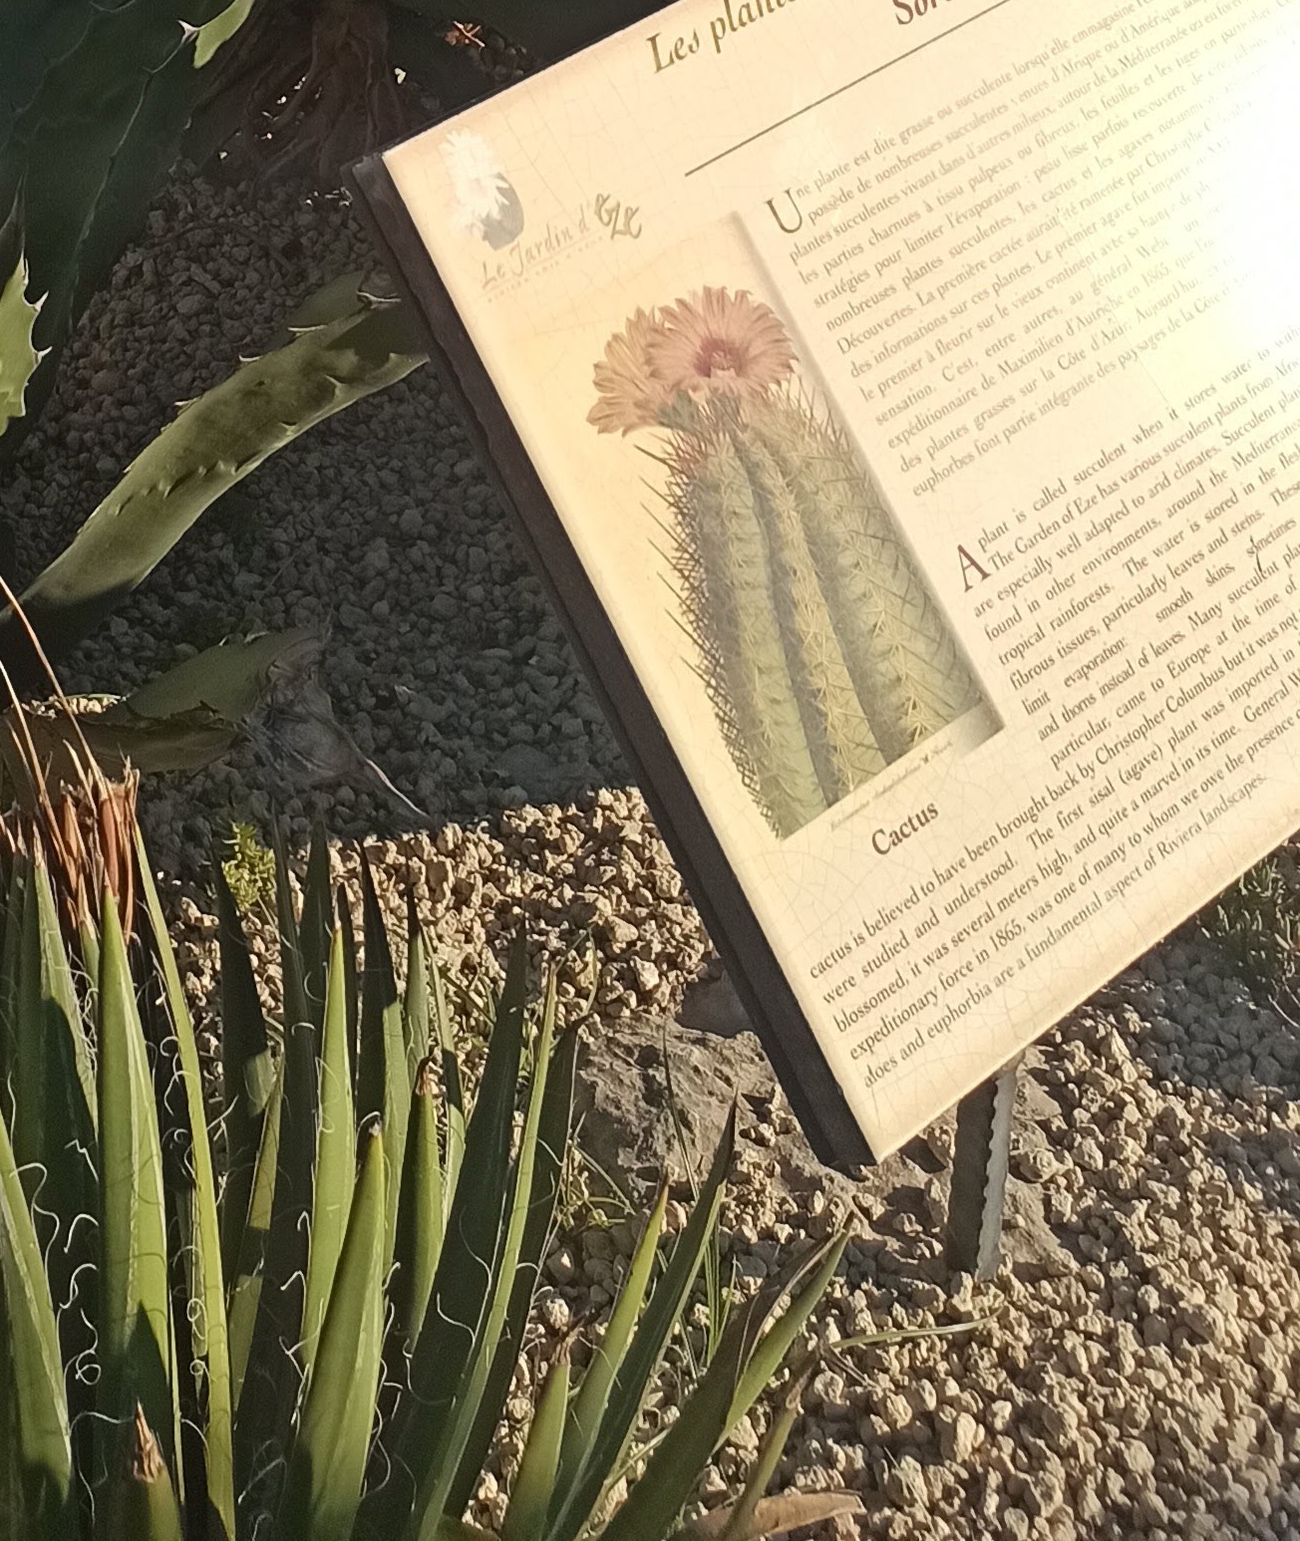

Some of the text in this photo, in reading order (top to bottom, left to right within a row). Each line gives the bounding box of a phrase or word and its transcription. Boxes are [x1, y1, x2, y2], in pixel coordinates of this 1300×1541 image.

[644, 28, 700, 74] Les
[481, 260, 506, 290] Le
[509, 222, 573, 277] Jardin
[957, 543, 992, 593] A
[977, 520, 1009, 553] plant
[1011, 507, 1027, 524] is
[1032, 476, 1068, 512] called
[1072, 442, 1127, 485] succulent
[1131, 419, 1164, 445] when
[1164, 405, 1179, 421] it
[1183, 382, 1217, 411] stores
[973, 597, 994, 618] are
[996, 554, 1053, 601] especially
[1055, 531, 1082, 559] well
[1084, 498, 1130, 542] adapted
[1130, 494, 1145, 509] to
[1147, 470, 1171, 499] arid
[1220, 404, 1276, 446] Succulent
[987, 376, 1274, 571] The Garden of Eze has various succulent plants from
[997, 621, 1046, 666] tropical
[1121, 555, 1149, 577] The
[1151, 529, 1184, 558] water
[1185, 517, 1201, 533] is
[1203, 486, 1239, 523] stored
[1240, 481, 1255, 496] in
[1257, 466, 1276, 485] the
[1008, 654, 1055, 691] fibrous
[1101, 573, 1167, 632] particularly
[1165, 549, 1205, 579] leaves
[1207, 526, 1229, 554] and
[809, 611, 1299, 979] cactus is believed to have been brought back by Christopher Columbus but it was not
[822, 975, 857, 1004] were
[860, 928, 910, 978] studied
[913, 905, 940, 939] and
[1025, 826, 1054, 850] The
[1055, 803, 1084, 830] first
[1088, 774, 1116, 808] sisal
[1117, 742, 1163, 785] (agave)
[1167, 719, 1198, 754] plant
[1200, 700, 1225, 722] was
[1224, 653, 1279, 703] imported
[1280, 647, 1295, 663] in
[849, 985, 938, 1060] expeditionary
[937, 959, 974, 992] force
[971, 947, 990, 965] in
[1025, 900, 1053, 923] was
[1053, 881, 1077, 905] one
[1077, 862, 1092, 886] of
[1092, 841, 1126, 875] many
[1126, 831, 1142, 848] to
[1141, 802, 1180, 835] whom
[1179, 788, 1199, 807] we
[1199, 768, 1224, 793] owe
[1224, 753, 1245, 773] the
[1245, 715, 1295, 763] presence
[871, 802, 939, 855] Cactus
[906, 960, 922, 978] it
[921, 942, 950, 967] was
[950, 900, 996, 948] several
[996, 874, 1039, 913] meters
[1073, 823, 1097, 855] and
[1097, 806, 1129, 838] quite
[1130, 798, 1140, 812] a
[1139, 760, 1181, 804] marvel
[1177, 756, 1195, 773] in
[1192, 744, 1211, 762] its
[1242, 678, 1290, 723] General
[863, 1055, 898, 1088] aloes
[899, 1026, 925, 1061] and
[926, 981, 993, 1039] euphorbia
[992, 965, 1015, 988] are
[1015, 957, 1026, 970] a
[1023, 889, 1103, 962] fundamental
[1103, 865, 1143, 902] aspect
[1143, 847, 1157, 871] of
[1155, 821, 1202, 860] Riviera
